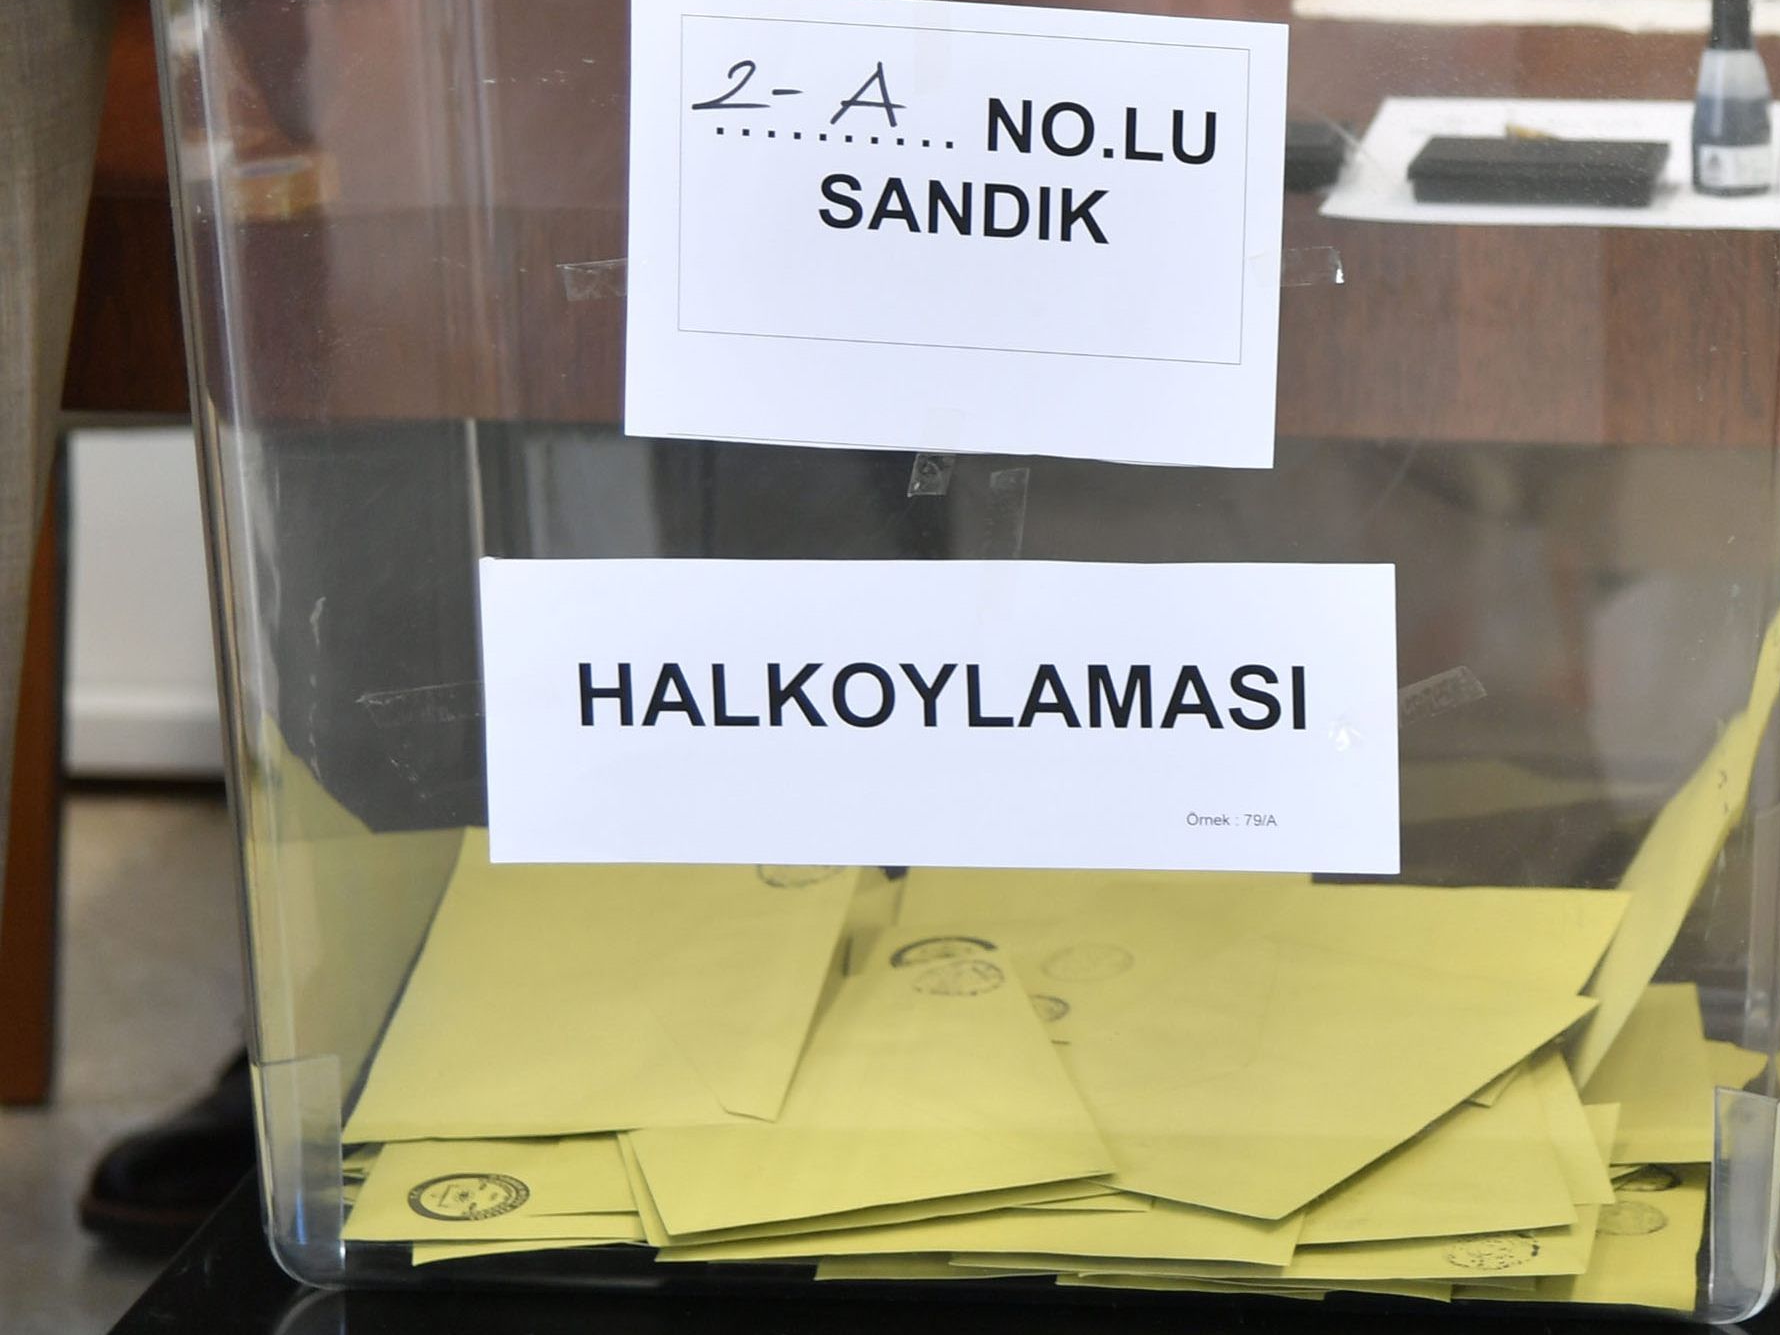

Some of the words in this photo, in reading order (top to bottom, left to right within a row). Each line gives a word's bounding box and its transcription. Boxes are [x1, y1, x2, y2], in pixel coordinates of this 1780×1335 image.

[987, 97, 1217, 165] NO.LU
[818, 173, 1109, 244] SANDIK
[578, 662, 1307, 731] HALKOYLAMASI
[1244, 813, 1278, 827] 79/A
